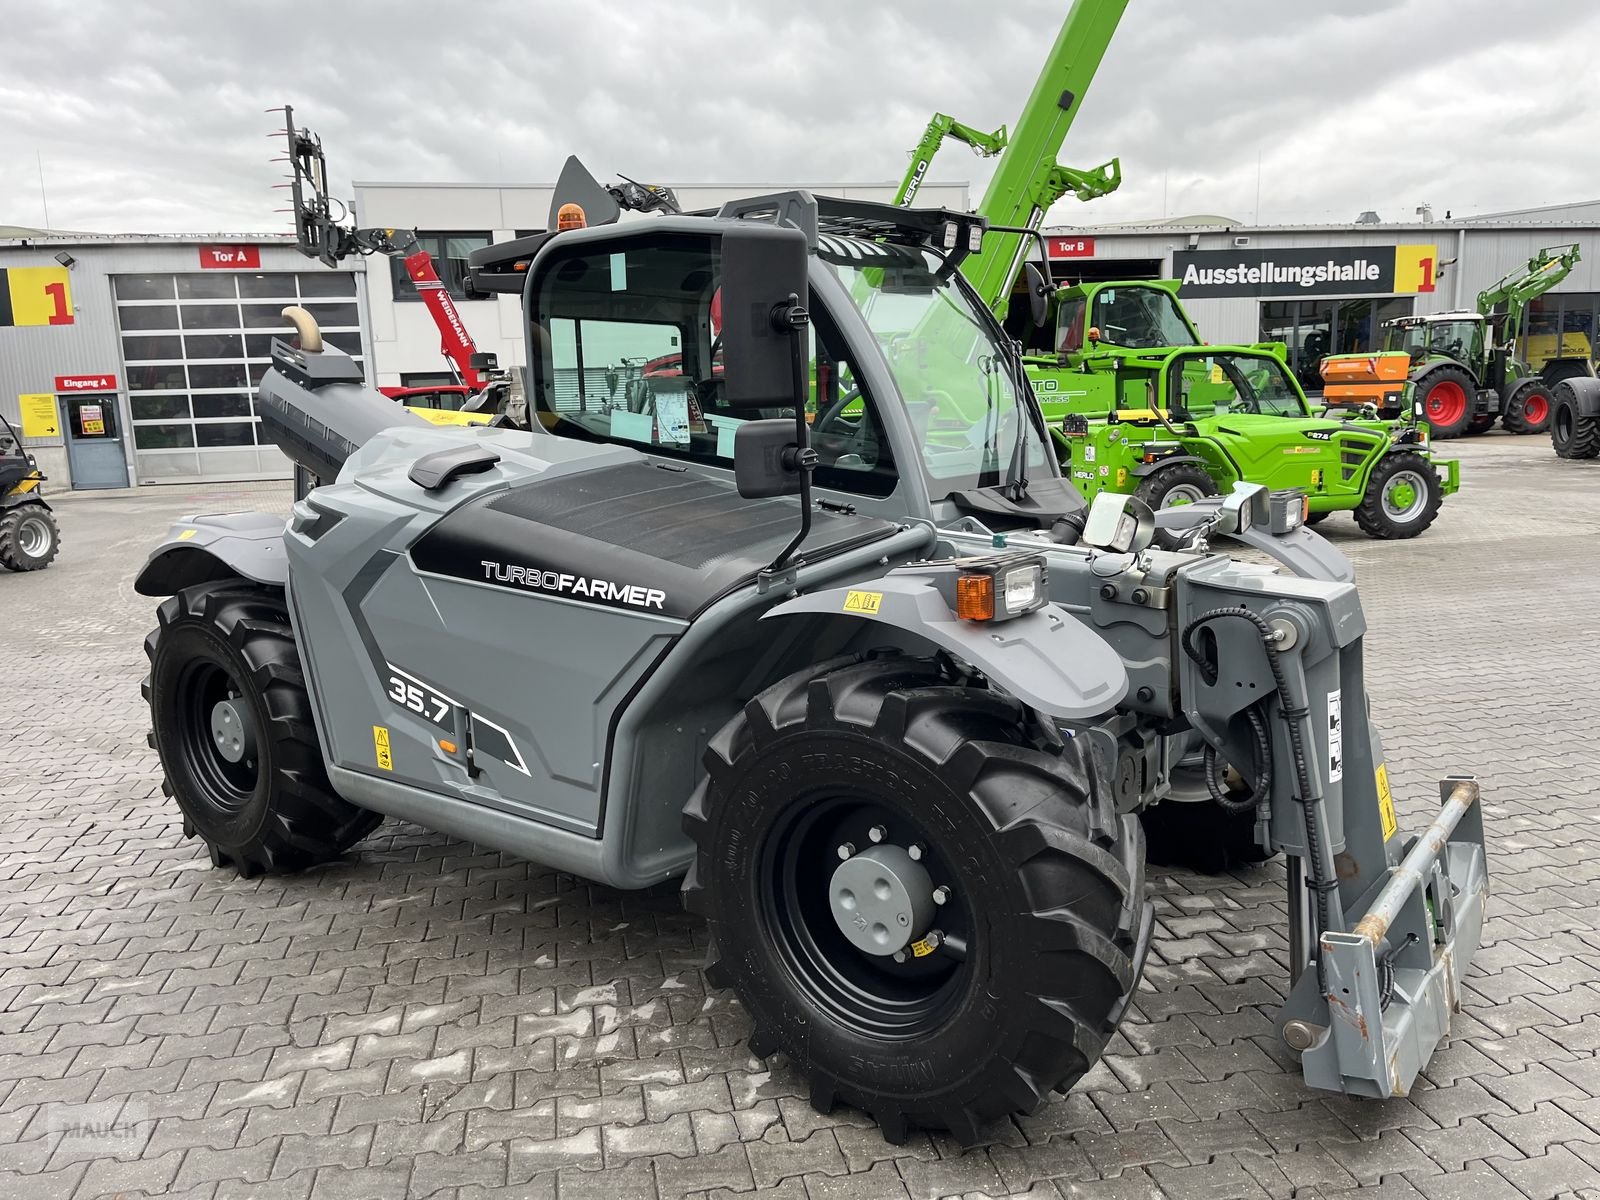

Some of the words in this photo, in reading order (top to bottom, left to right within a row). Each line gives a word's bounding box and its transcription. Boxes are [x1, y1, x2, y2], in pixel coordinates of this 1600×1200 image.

[212, 250, 234, 262] Tor
[236, 250, 247, 262] A
[1059, 241, 1075, 251] Tor
[1077, 241, 1085, 251] B
[1182, 259, 1380, 287] Ausstellungshalle
[1417, 258, 1436, 292] 1
[45, 282, 75, 325] 1
[437, 291, 469, 347] WEIDEMANN
[63, 379, 99, 388] Eingang
[1074, 471, 1094, 480] MERLO
[481, 560, 666, 609] TURBOFARMER
[388, 676, 449, 723] 35.7
